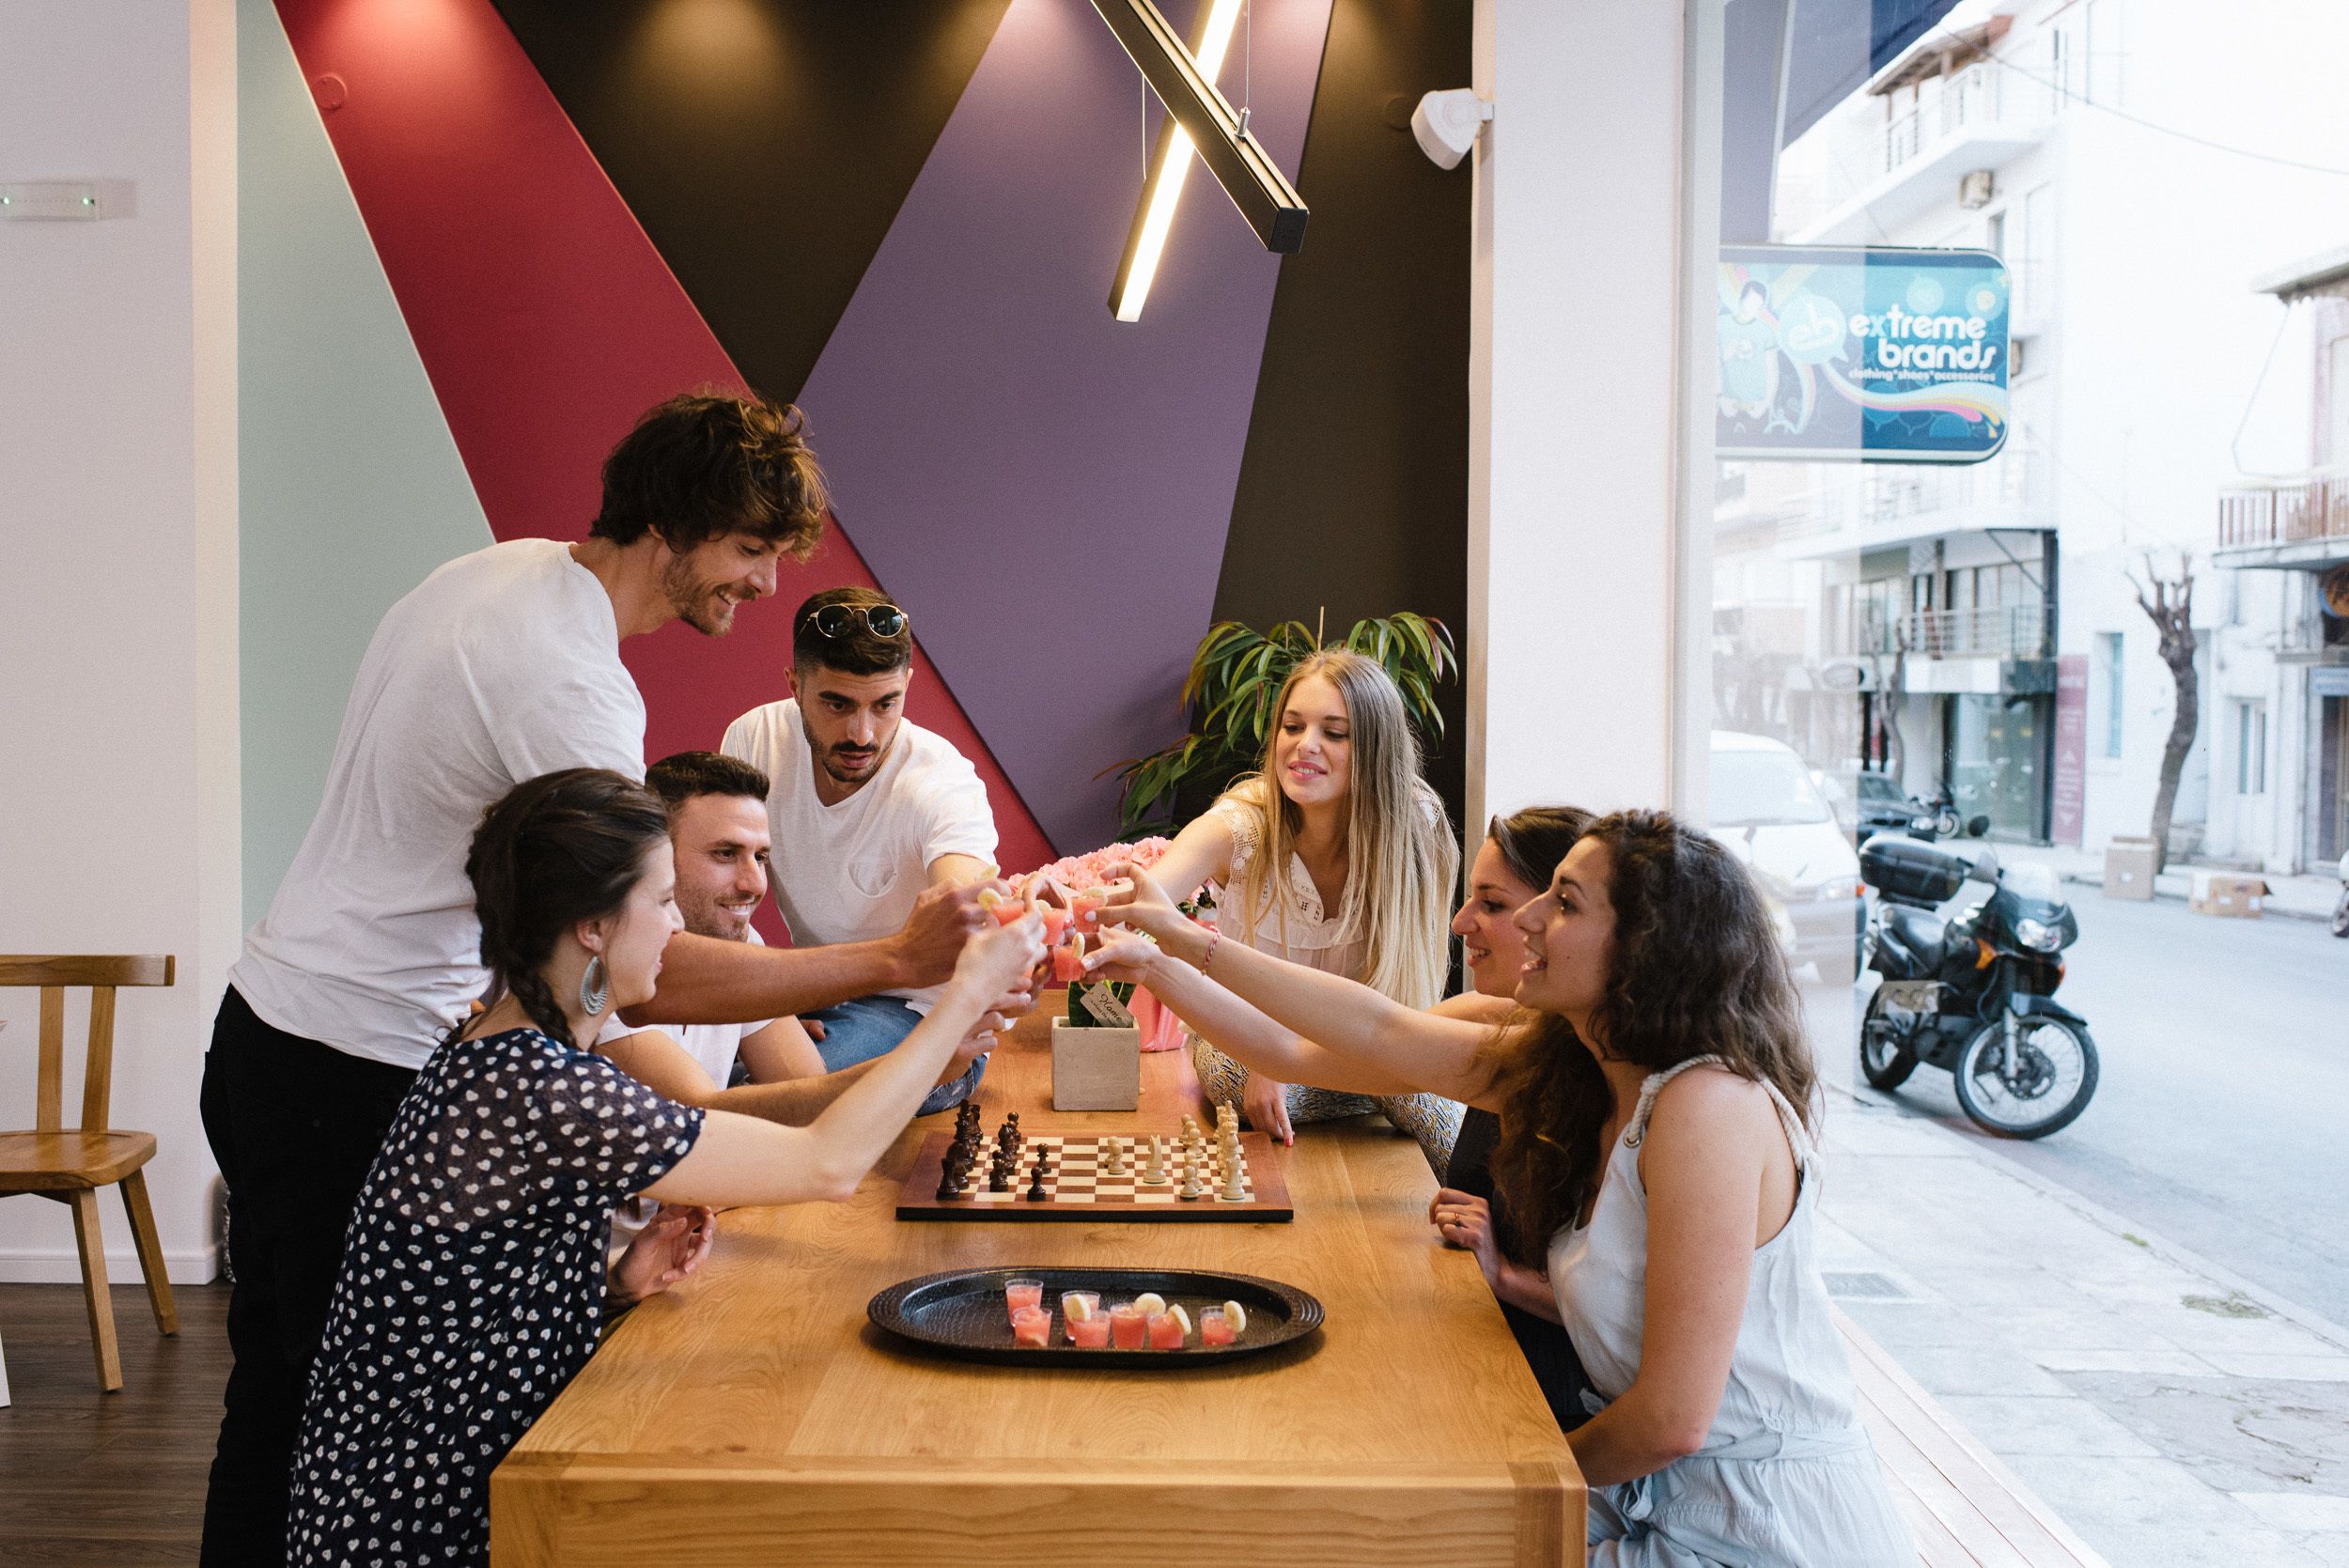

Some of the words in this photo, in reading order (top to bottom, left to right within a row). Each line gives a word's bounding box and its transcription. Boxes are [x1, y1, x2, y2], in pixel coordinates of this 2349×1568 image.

[1849, 303, 1987, 340] extreme
[1877, 337, 1998, 370] brands
[1099, 993, 1123, 1022] Home
